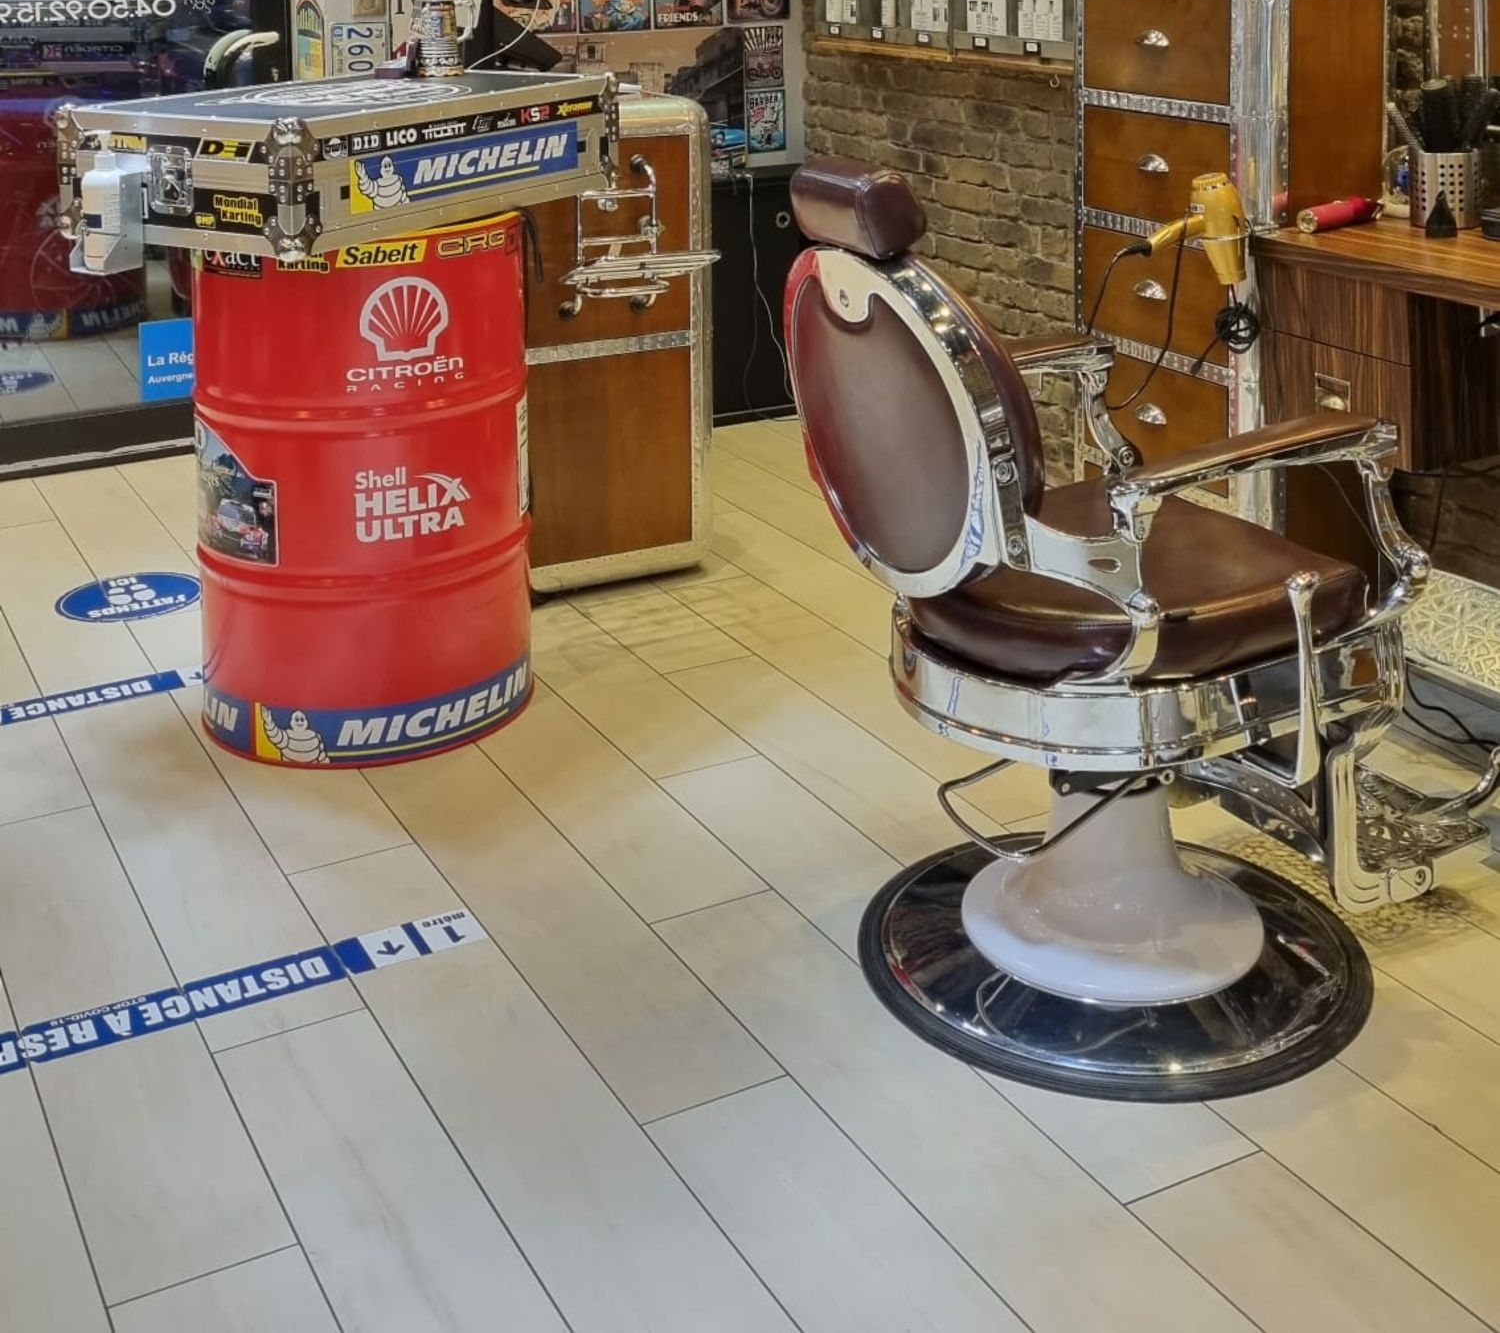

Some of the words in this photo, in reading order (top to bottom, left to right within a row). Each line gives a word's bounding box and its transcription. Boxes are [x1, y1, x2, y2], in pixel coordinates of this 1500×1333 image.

[657, 11, 699, 24] FRIENDS
[386, 128, 418, 147] LICO
[520, 106, 550, 123] KS2
[413, 133, 568, 185] MICHELIN
[214, 195, 259, 211] Mondial
[221, 209, 263, 227] Karting
[342, 242, 418, 266] Sabelt
[147, 353, 166, 368] La
[355, 467, 406, 490] Shell
[353, 473, 471, 518] HELIX
[355, 505, 466, 543] ULTRA
[108, 576, 138, 588] ICI
[8, 679, 153, 720] DISTANCE
[336, 661, 529, 747] MICHELIN
[421, 910, 467, 930] mètre
[112, 995, 148, 1010] STOP
[140, 954, 332, 1028] DISTANCE
[49, 1005, 112, 1028] COVID-19
